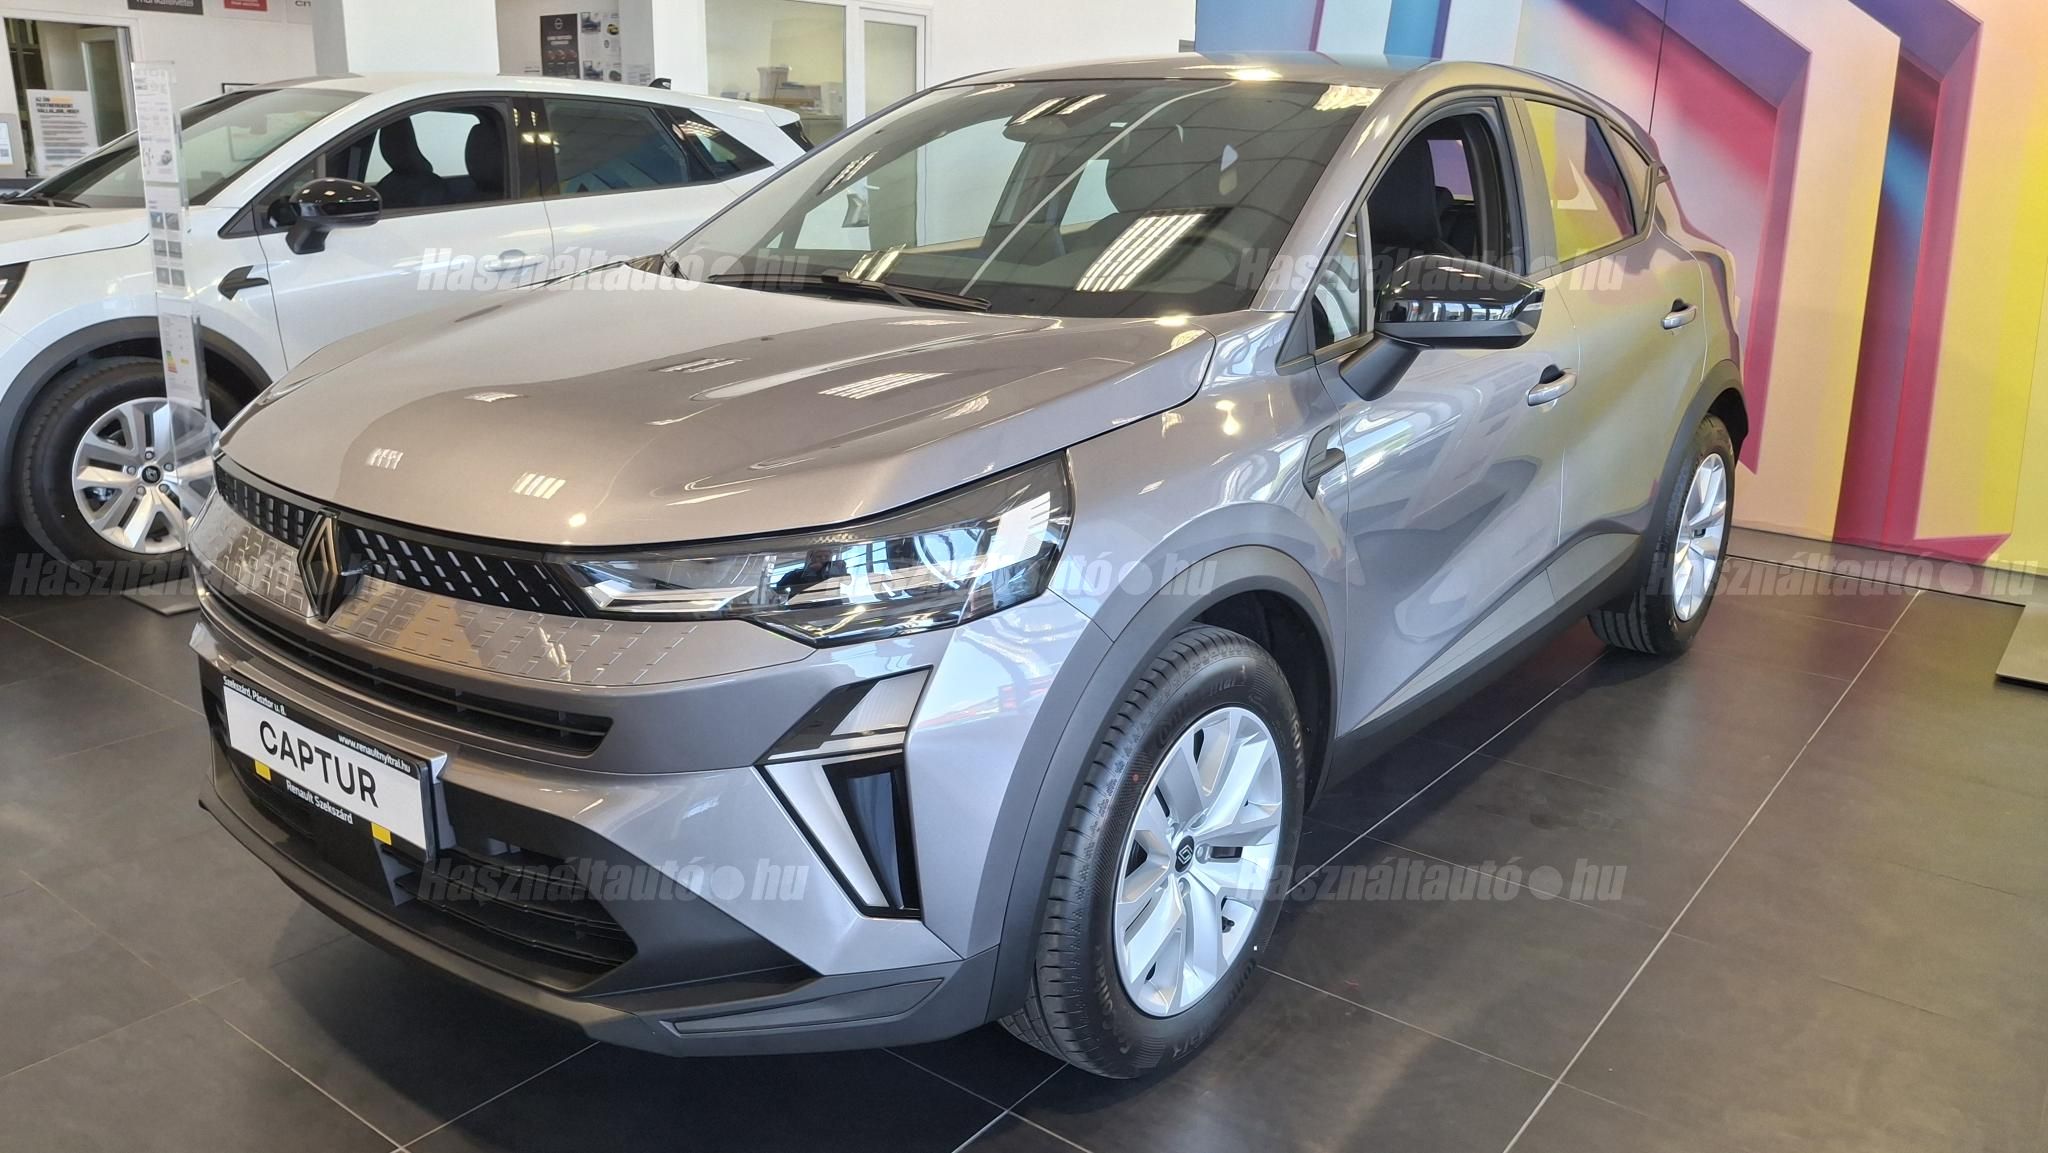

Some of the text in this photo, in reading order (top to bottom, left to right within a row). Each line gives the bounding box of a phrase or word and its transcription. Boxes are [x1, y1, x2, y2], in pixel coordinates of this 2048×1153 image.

[259, 720, 379, 809] CAPTUR
[285, 779, 354, 825] Renault Szekszárd
